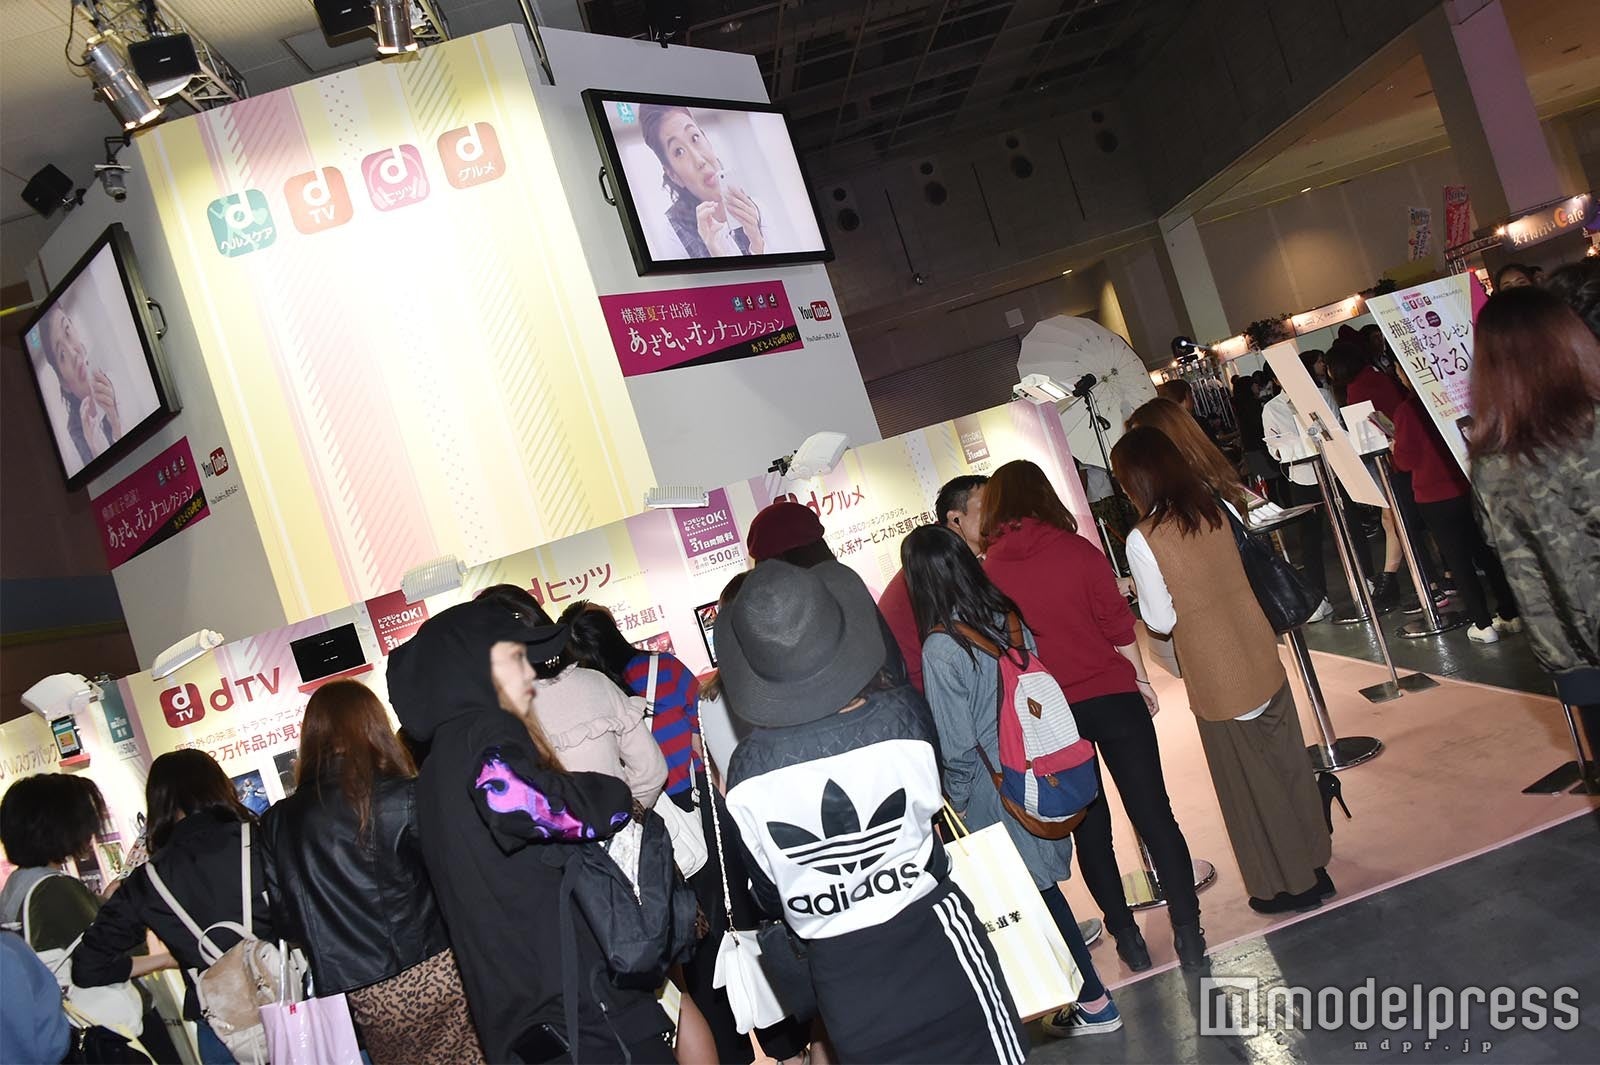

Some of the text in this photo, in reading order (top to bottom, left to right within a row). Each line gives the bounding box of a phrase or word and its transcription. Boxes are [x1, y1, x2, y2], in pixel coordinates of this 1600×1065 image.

[457, 162, 495, 182] グルメ
[384, 185, 416, 206] ヒッツ
[308, 204, 336, 225] TV
[220, 226, 273, 251] ヘルスケア
[798, 302, 831, 321] YouTube
[705, 509, 728, 525] OK!
[690, 531, 734, 552] 31日間無料
[708, 549, 740, 565] 500円
[401, 606, 424, 622] OK!
[176, 708, 194, 722] TV
[175, 704, 307, 751] 国内外の映画・ドラマ・アニメ
[208, 721, 303, 763] 2万作品が見
[787, 862, 920, 916] adidas
